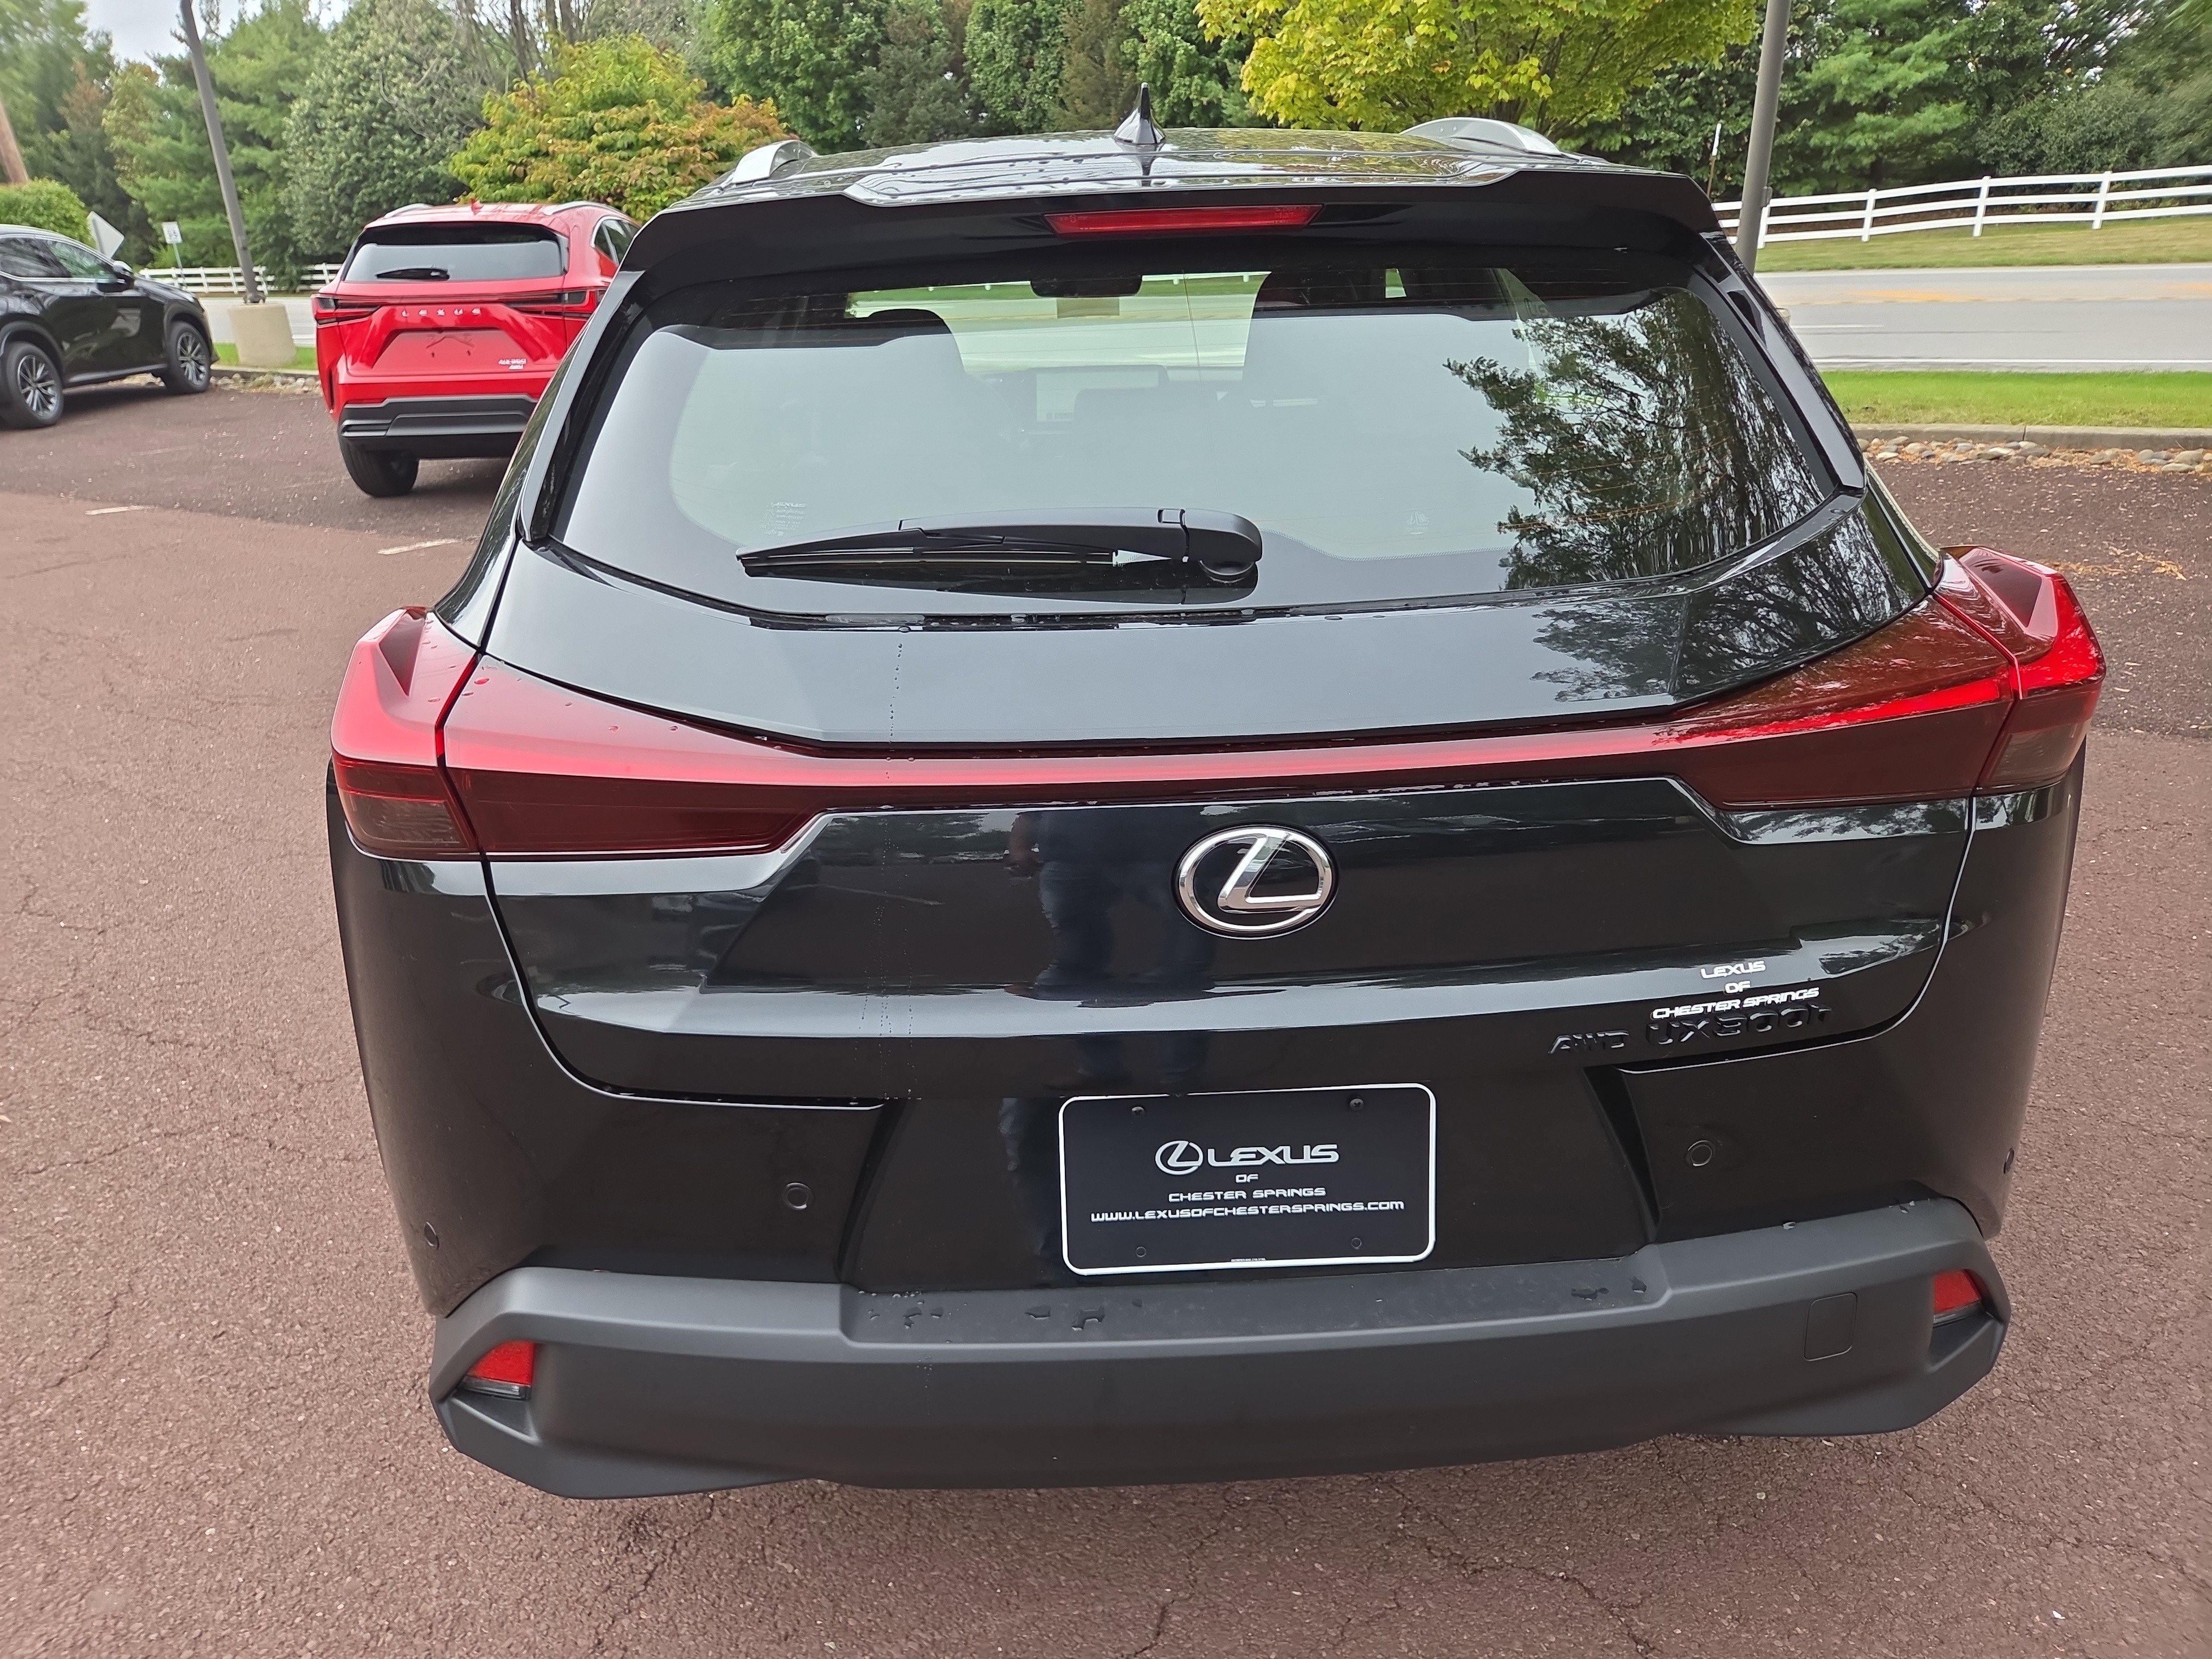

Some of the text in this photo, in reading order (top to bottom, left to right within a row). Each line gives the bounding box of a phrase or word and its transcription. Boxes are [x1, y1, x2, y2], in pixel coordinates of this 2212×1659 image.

[401, 308, 481, 317] LEXUS
[1700, 960, 1766, 979] LEXUS
[1725, 980, 1751, 994] OF
[1652, 987, 1820, 1019] CHESTER SPRINGS
[1547, 1030, 1629, 1054] AWD
[1207, 1144, 1340, 1167] LEXUS
[1235, 1173, 1259, 1184] OF
[1168, 1187, 1327, 1203] CHESTER SPRINGS
